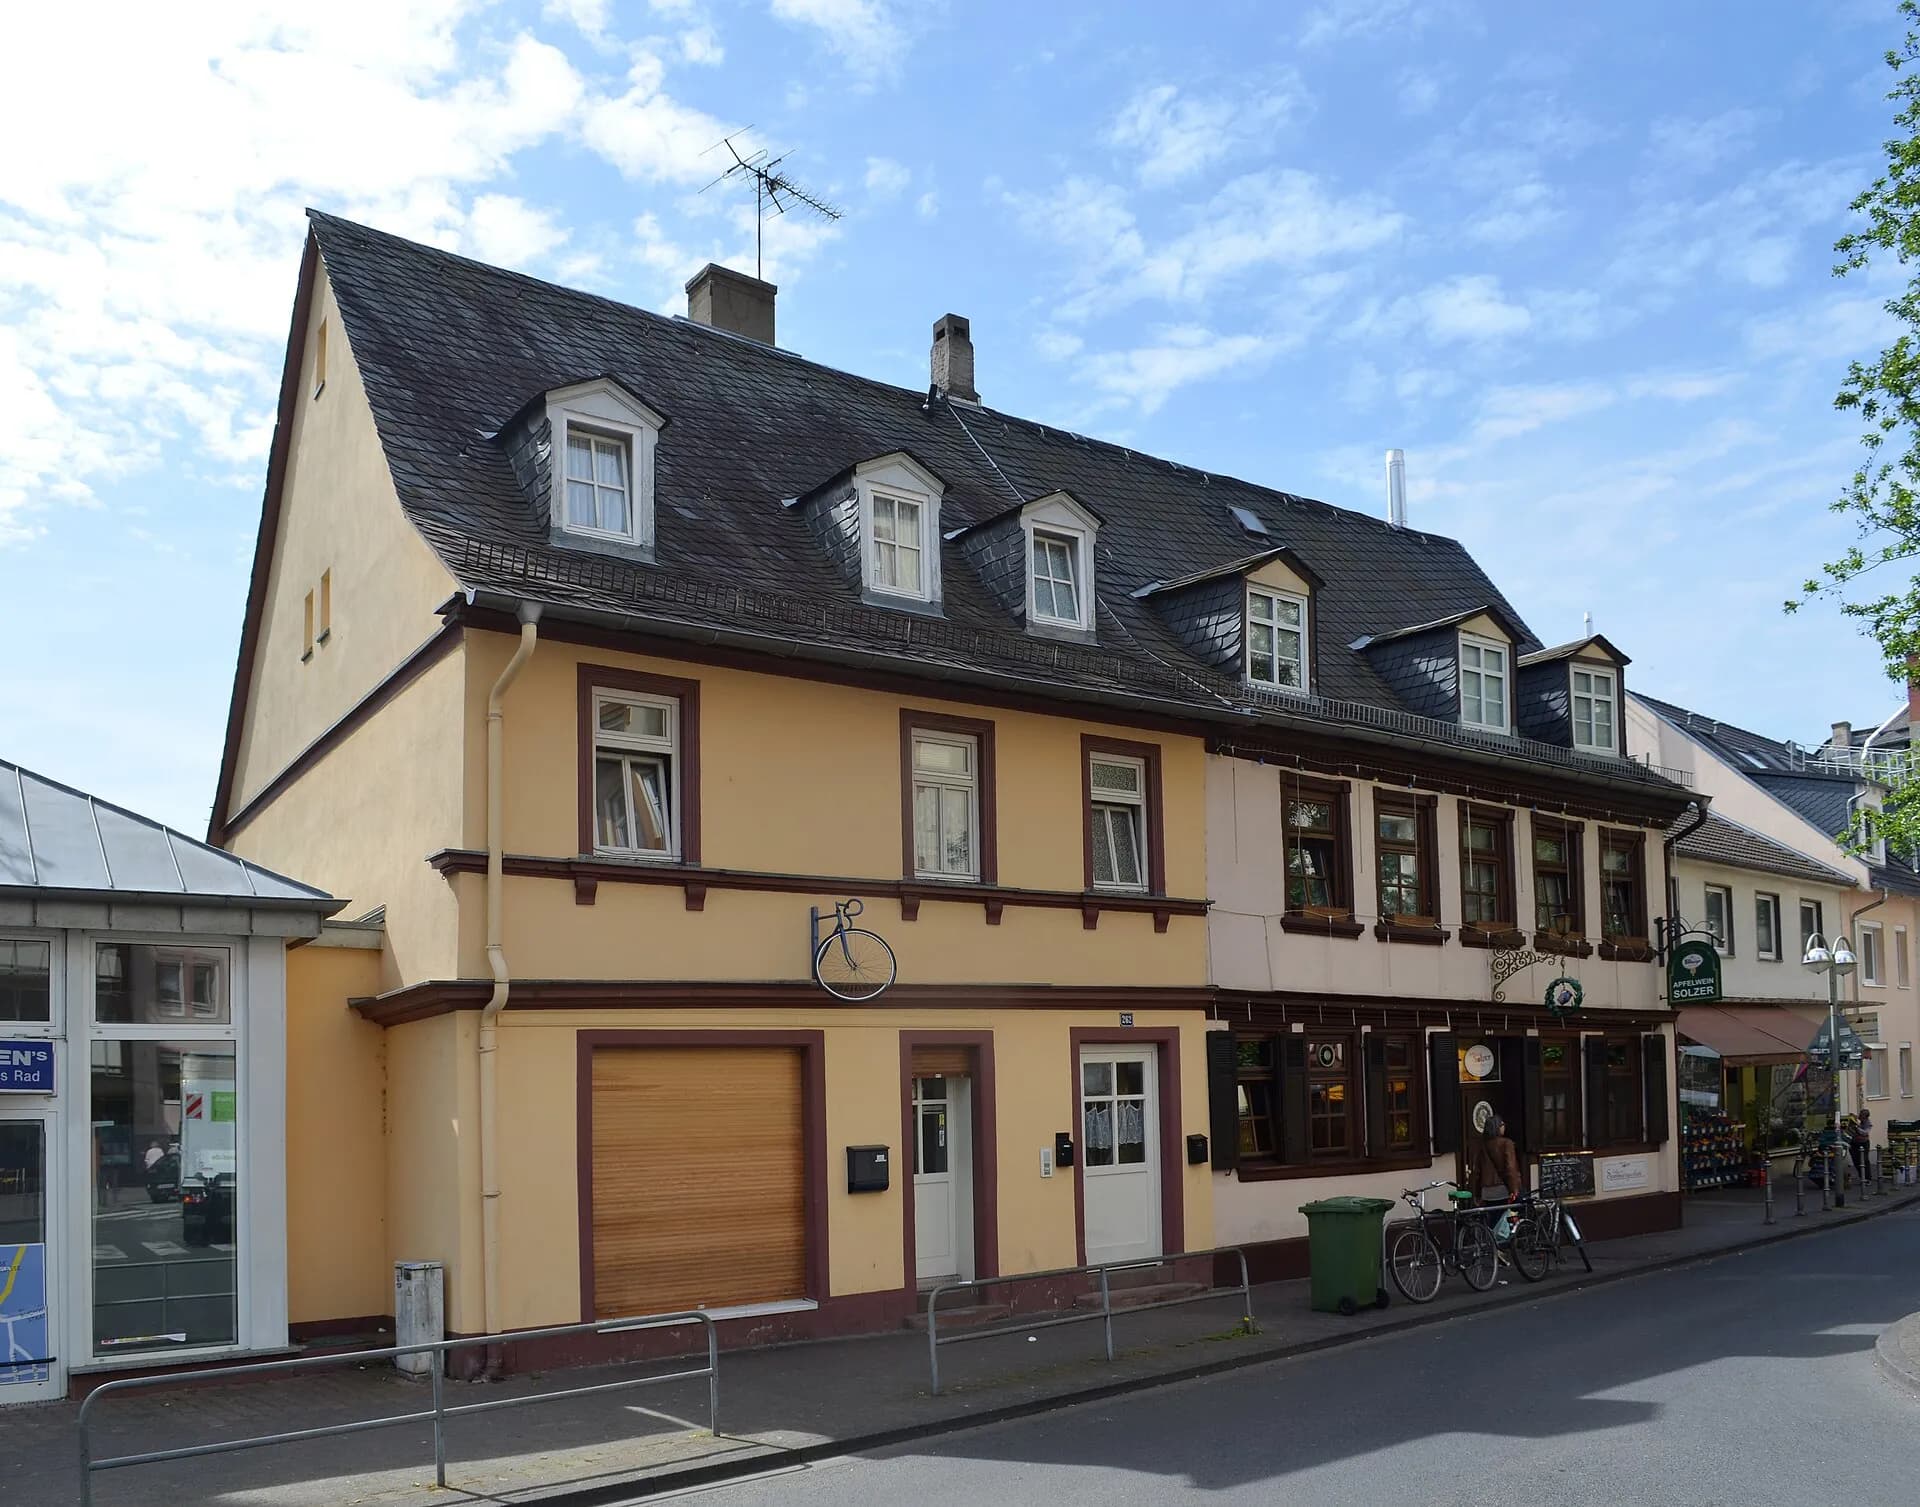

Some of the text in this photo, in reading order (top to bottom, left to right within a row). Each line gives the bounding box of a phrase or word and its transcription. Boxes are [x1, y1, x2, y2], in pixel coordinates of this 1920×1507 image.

[1673, 978, 1714, 988] APFELWEIN
[1673, 986, 1714, 998] SOLZER
[14, 1070, 40, 1081] Rad
